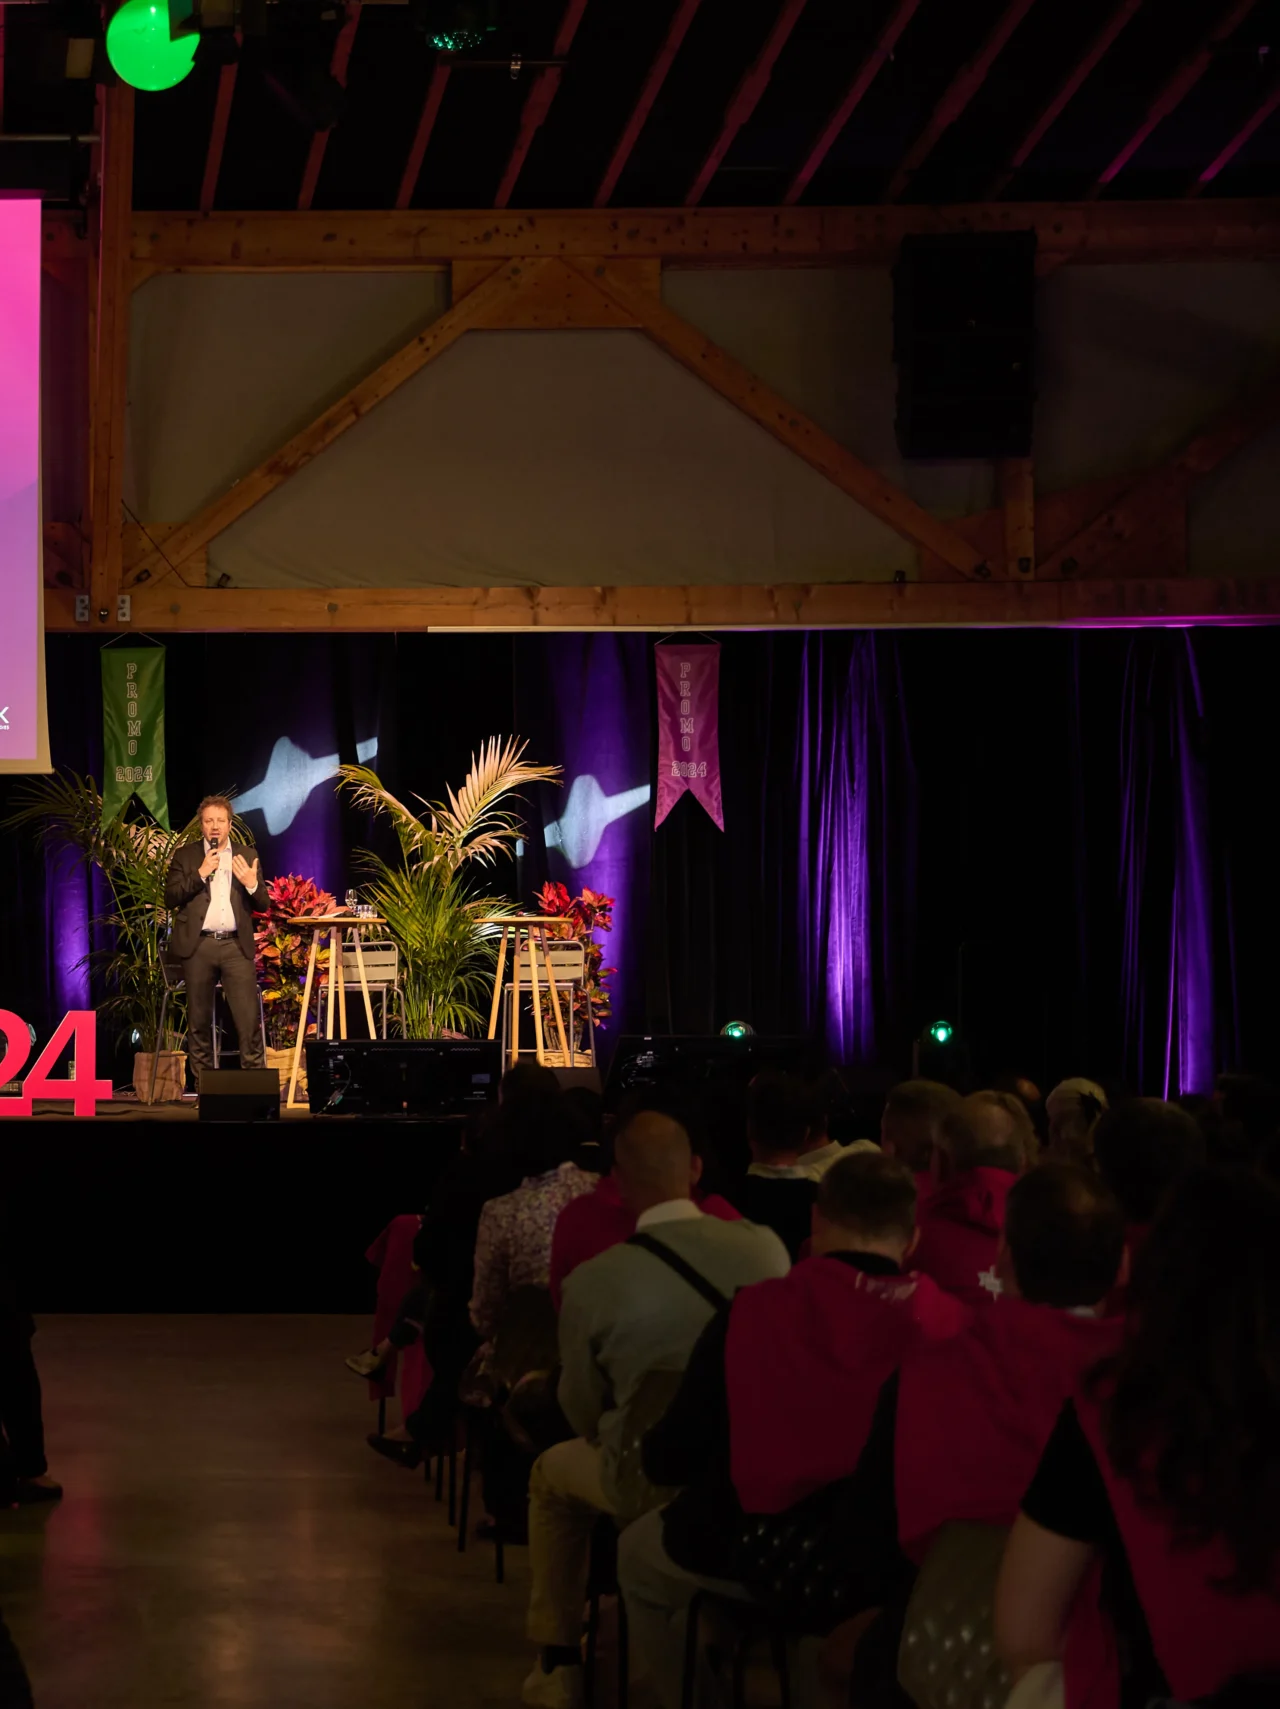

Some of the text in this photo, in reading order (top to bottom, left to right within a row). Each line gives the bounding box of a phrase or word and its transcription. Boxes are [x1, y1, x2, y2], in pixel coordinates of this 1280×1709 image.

[127, 664, 141, 755] PROMO
[680, 663, 694, 751] PROMO
[116, 766, 153, 782] 2024
[671, 761, 707, 777] 2024
